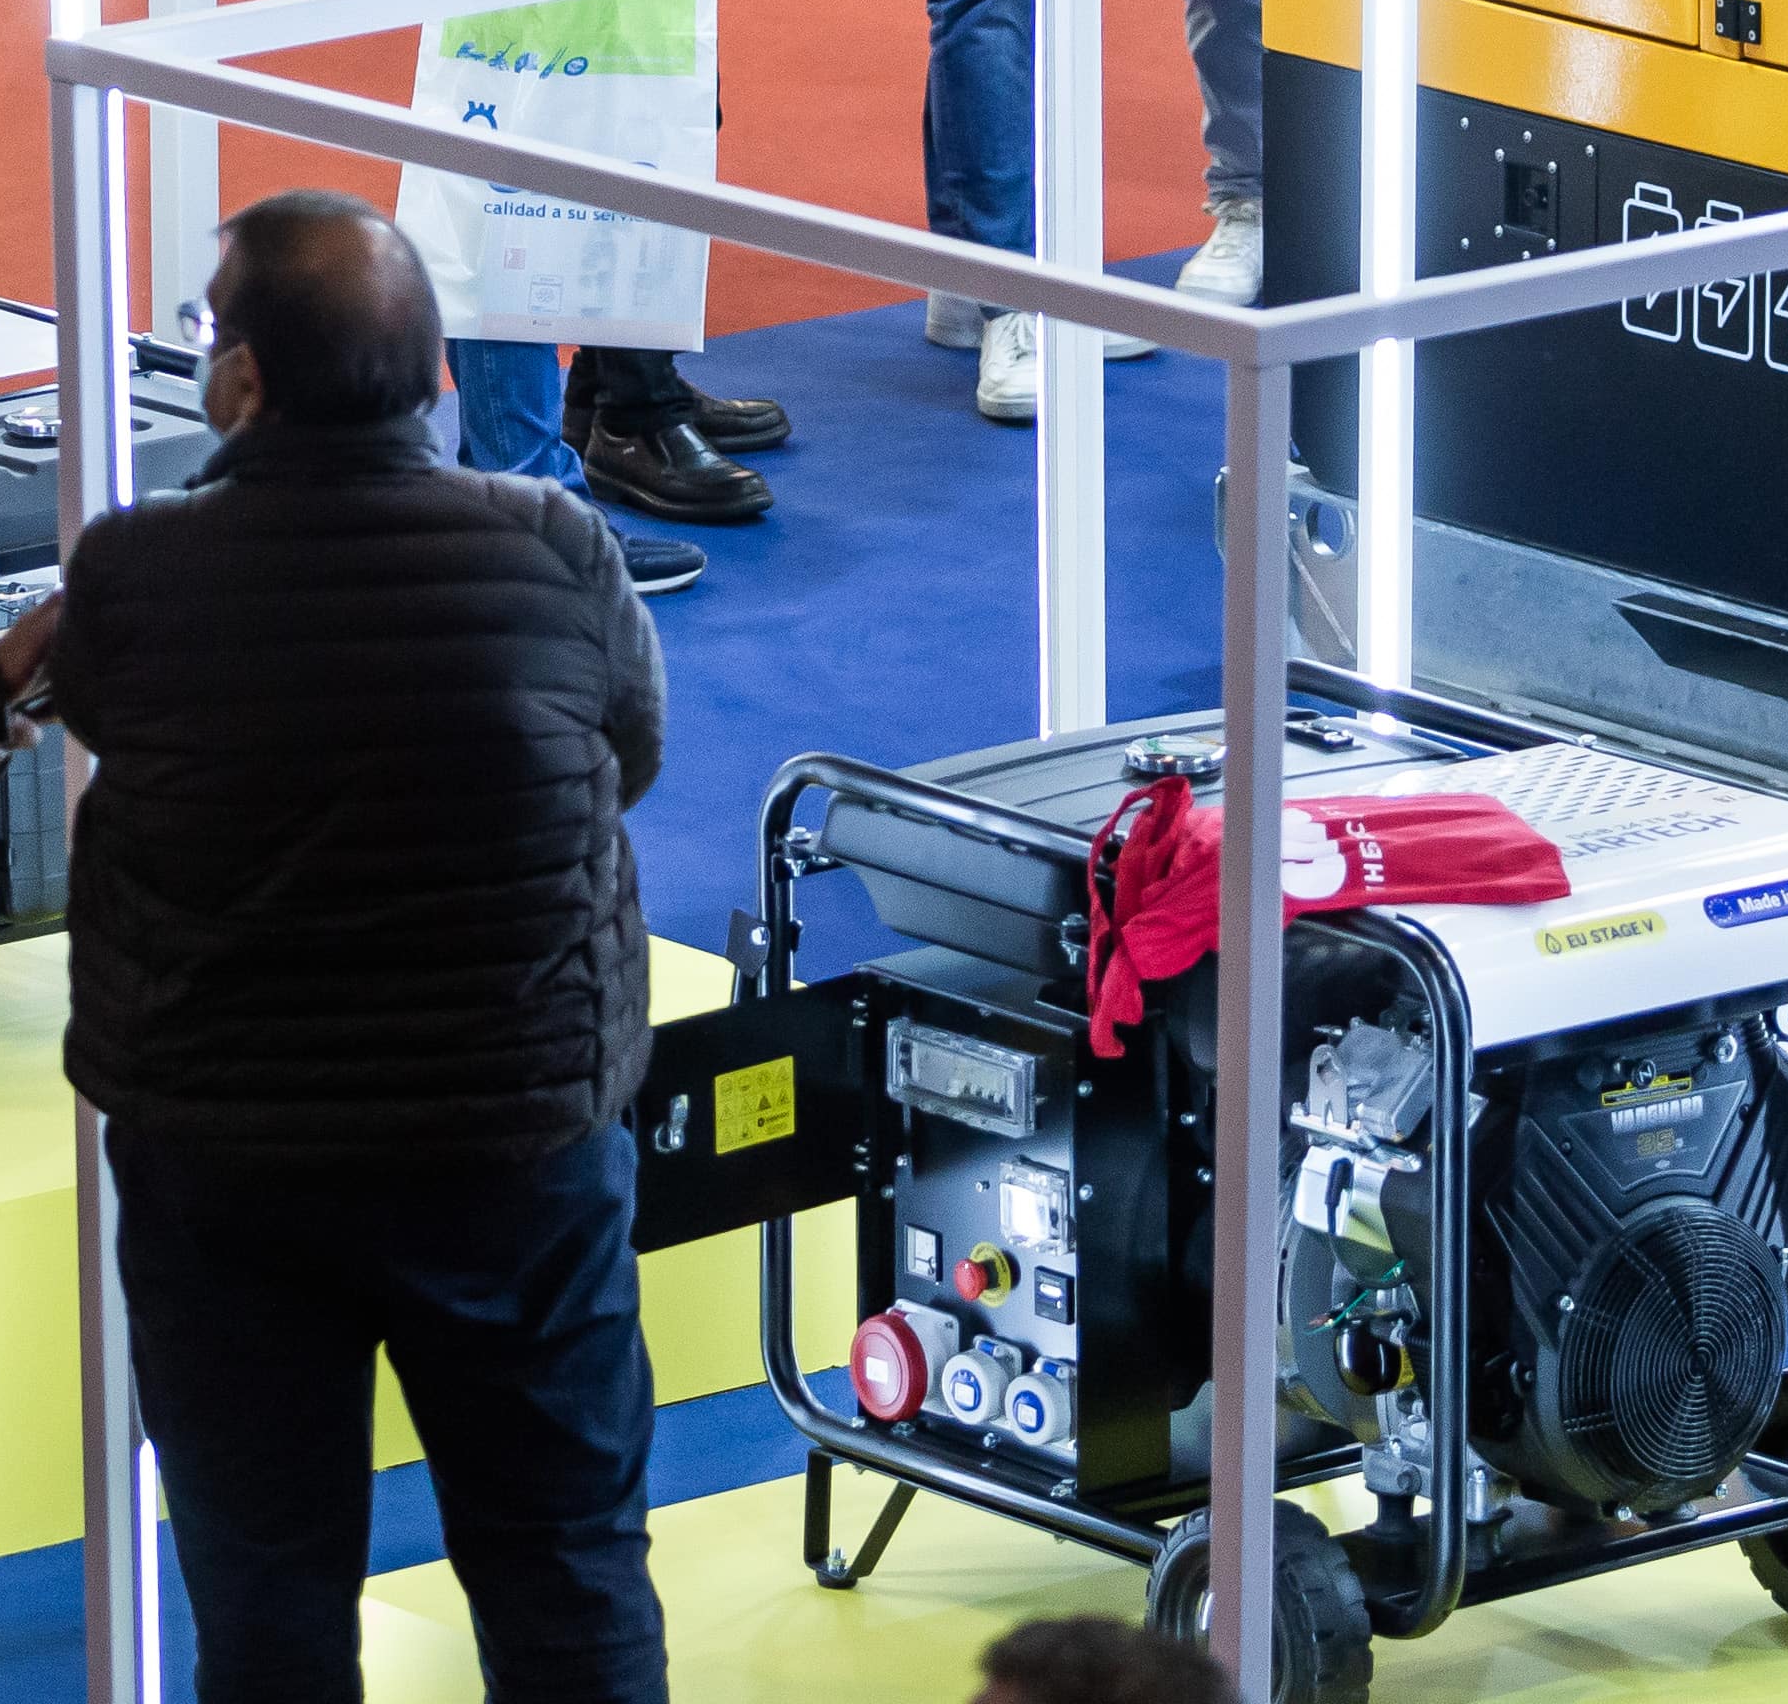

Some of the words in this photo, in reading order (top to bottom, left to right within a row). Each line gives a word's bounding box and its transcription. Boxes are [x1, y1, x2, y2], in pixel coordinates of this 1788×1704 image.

[483, 201, 546, 218] calidad
[552, 207, 561, 219] a
[568, 208, 587, 221] su
[1737, 896, 1782, 914] Made
[1566, 933, 1588, 949] EU
[1590, 922, 1640, 944] STAGE
[1642, 918, 1654, 934] V
